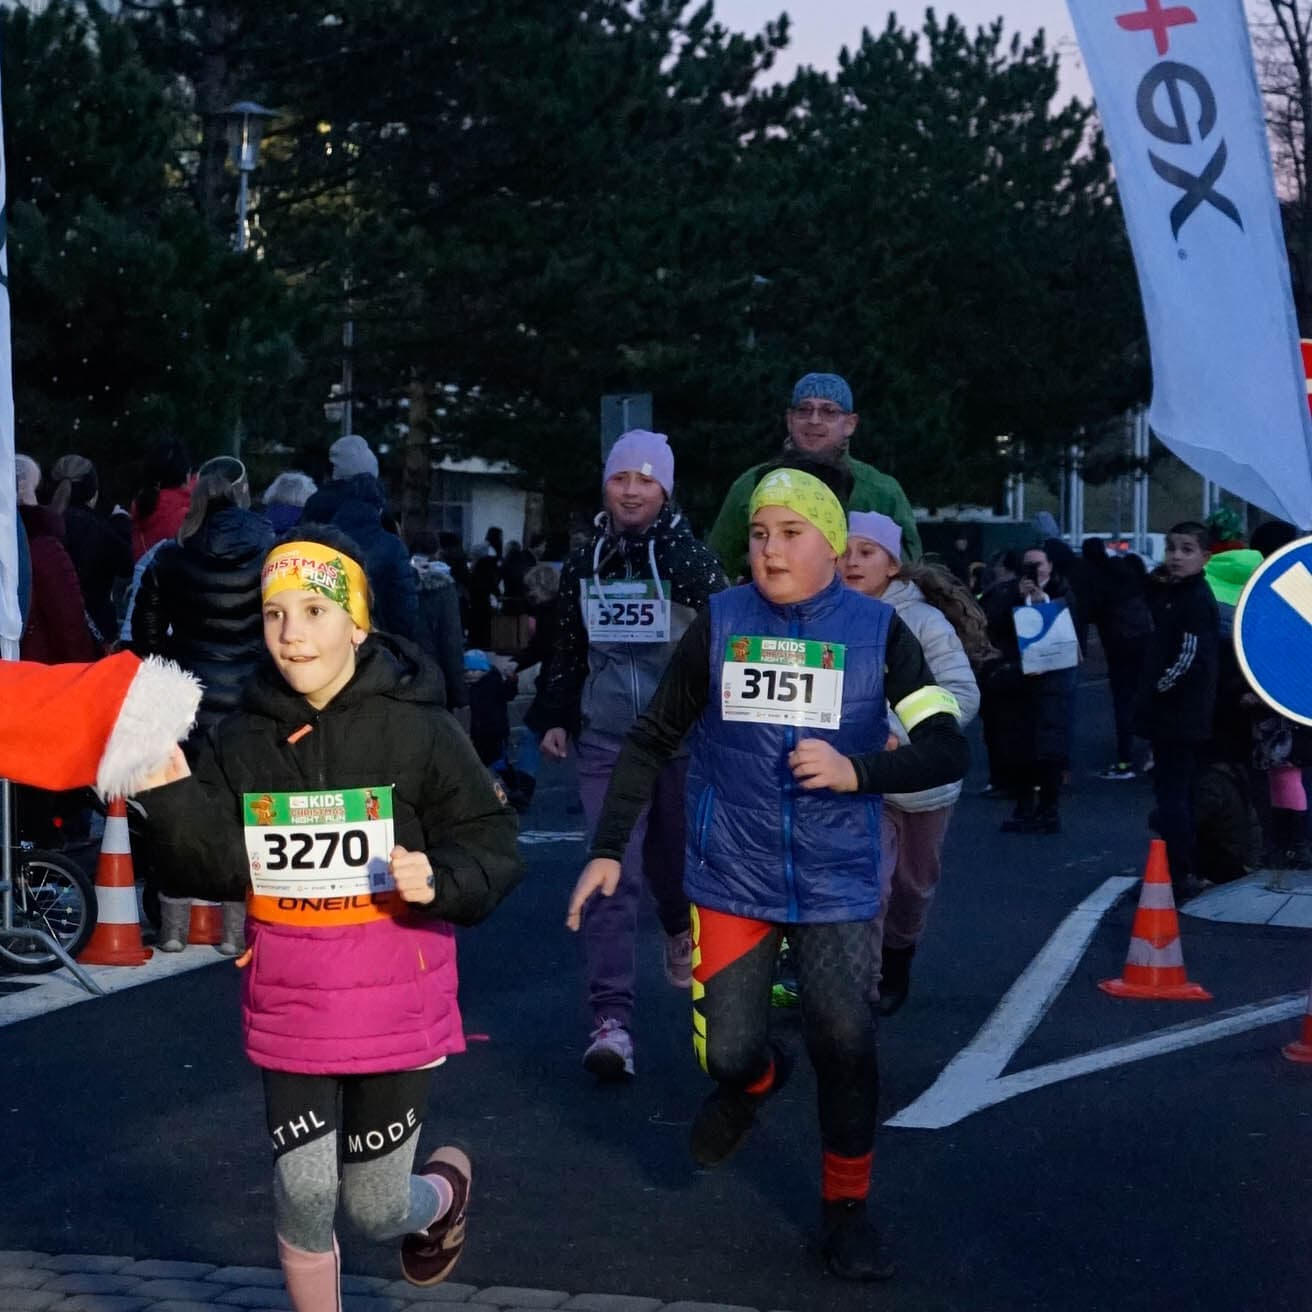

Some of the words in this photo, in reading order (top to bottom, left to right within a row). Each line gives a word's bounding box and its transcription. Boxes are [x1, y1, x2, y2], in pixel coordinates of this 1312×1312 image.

[598, 603, 655, 625] 3255
[777, 640, 806, 653] KIDS
[741, 668, 814, 704] 3151
[309, 794, 344, 808] KIDS
[264, 830, 369, 870] 3270
[348, 1108, 417, 1153] MODE
